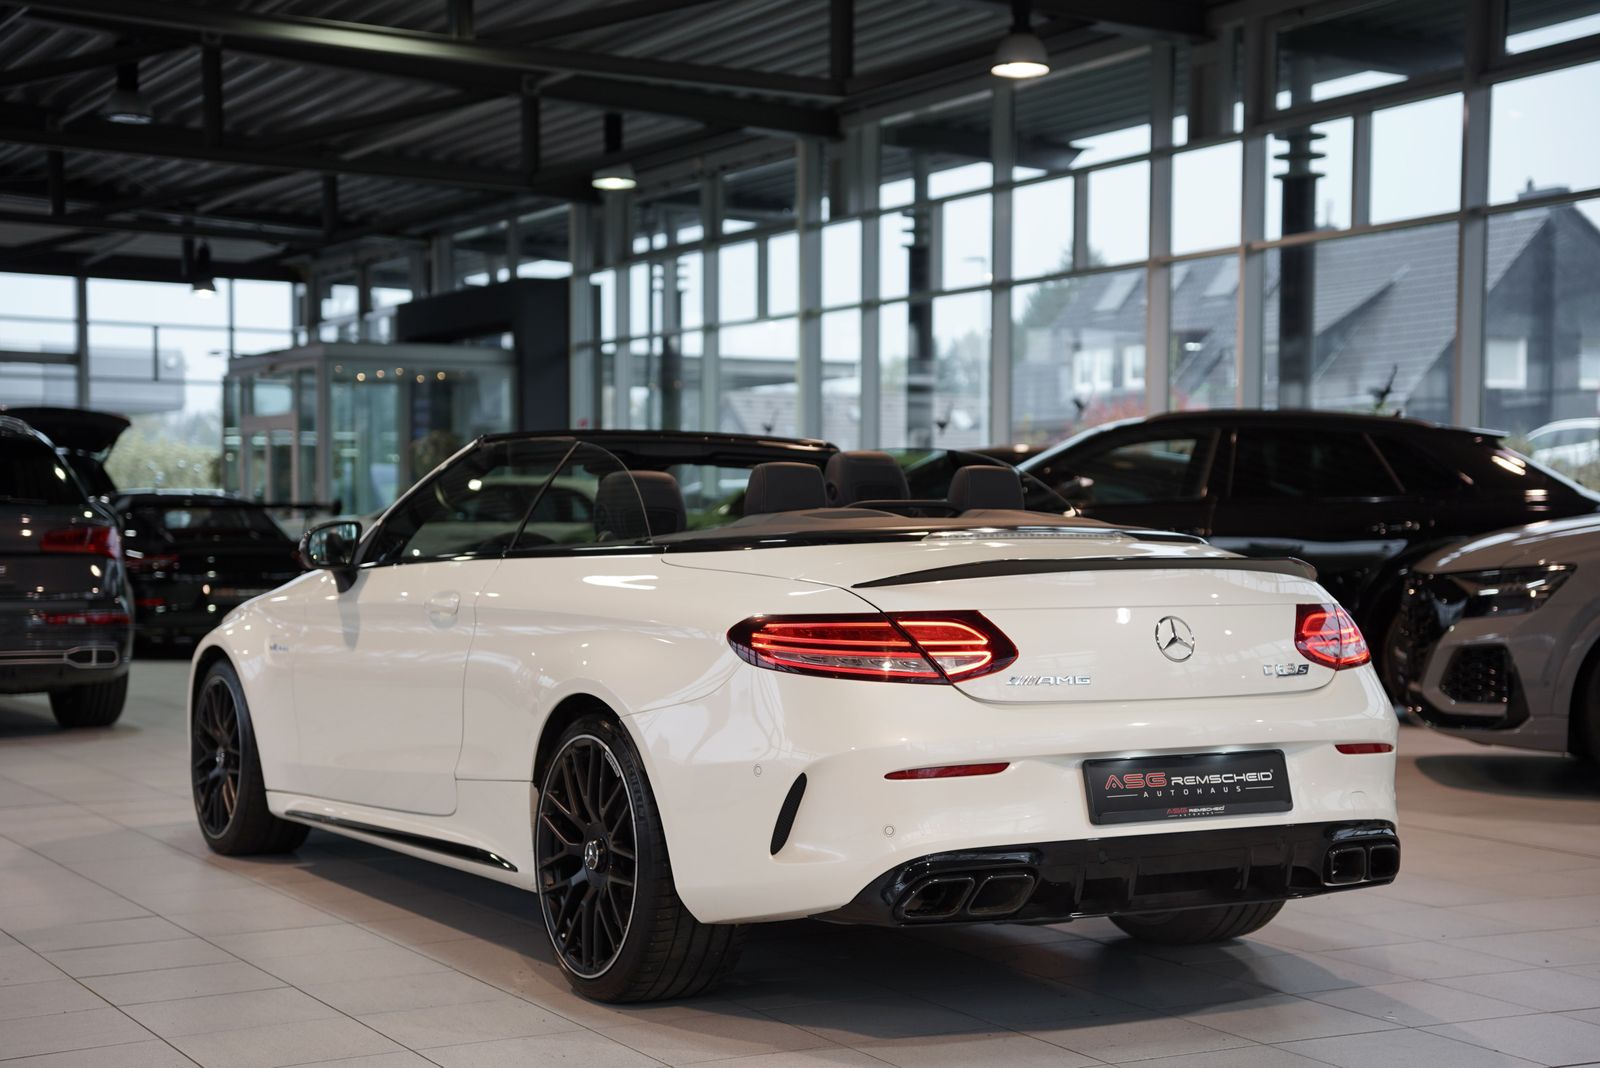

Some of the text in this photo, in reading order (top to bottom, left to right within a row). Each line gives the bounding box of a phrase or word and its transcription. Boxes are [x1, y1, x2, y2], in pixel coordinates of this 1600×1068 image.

[1034, 675, 1091, 686] AMG
[1105, 772, 1168, 790] ASG
[1143, 785, 1242, 798] AUTOHAUS
